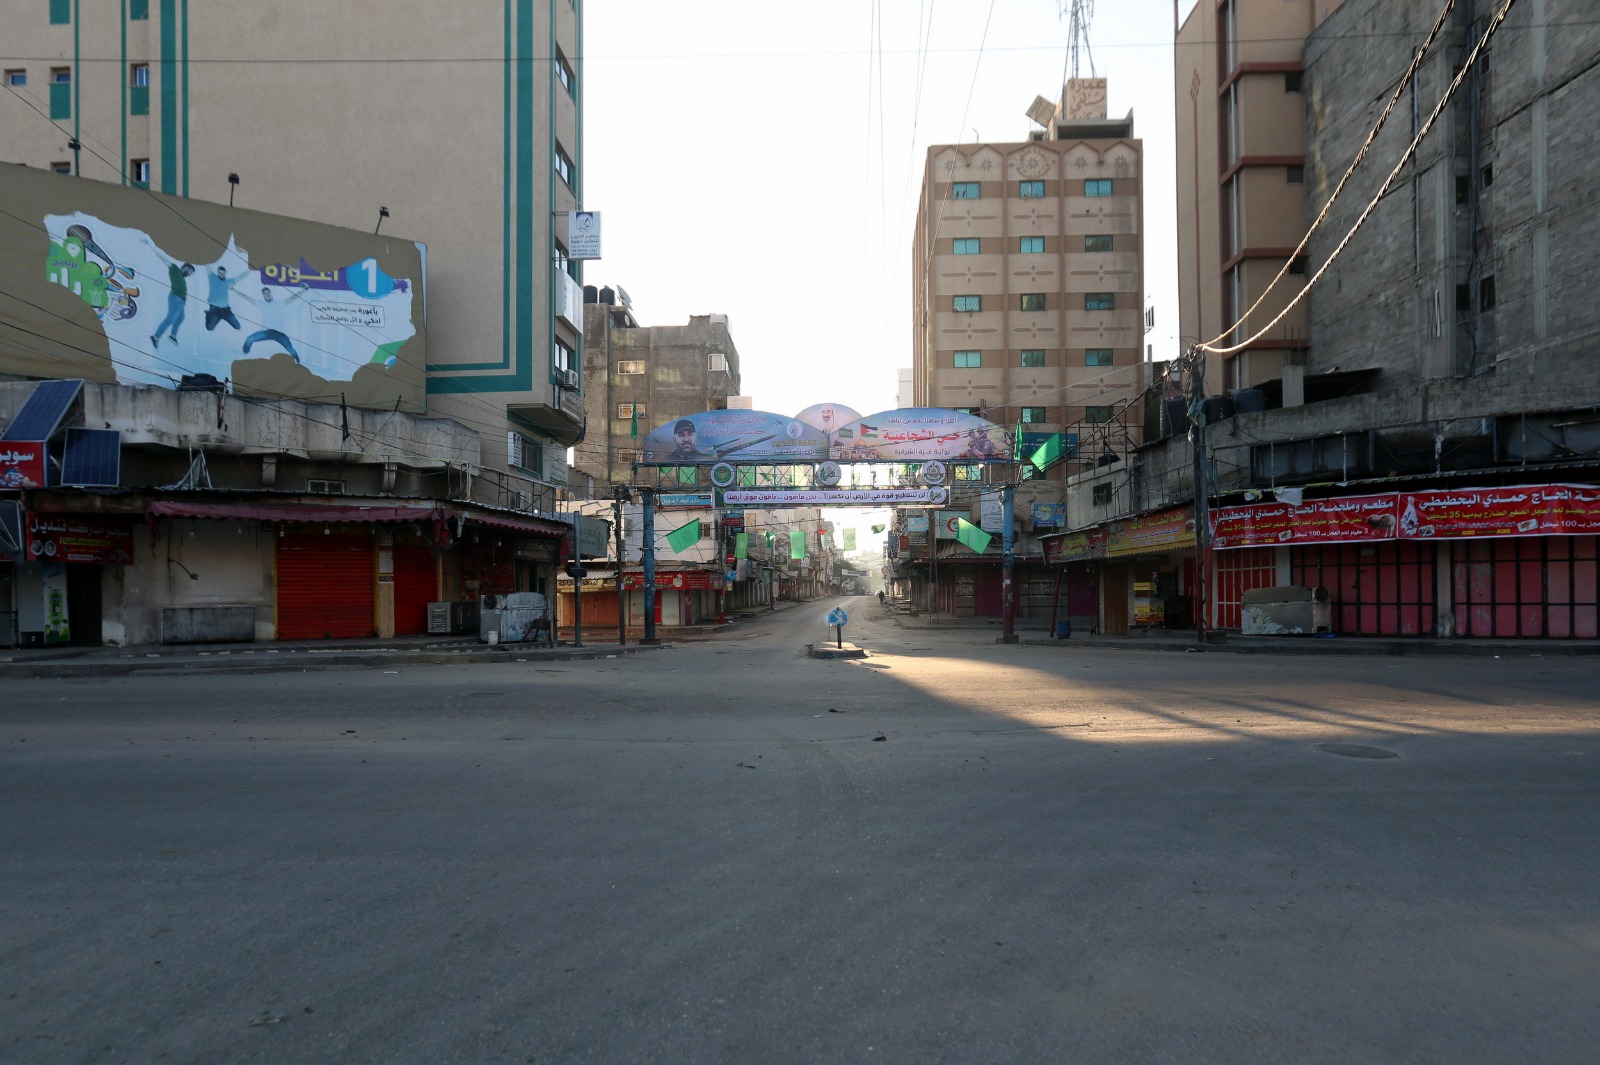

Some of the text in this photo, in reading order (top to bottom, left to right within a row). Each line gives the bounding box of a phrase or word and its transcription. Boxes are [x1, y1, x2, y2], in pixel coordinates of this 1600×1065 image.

[52, 259, 78, 269] برنامج
[362, 258, 376, 293] 1
[883, 428, 960, 445] حي الشجاعية
[894, 447, 918, 456] الشرقية
[871, 493, 880, 501] في
[895, 491, 918, 499] تستطيع
[918, 491, 926, 499] لن
[1482, 491, 1528, 507] حمدي
[1531, 490, 1572, 504] الحاج
[1319, 502, 1360, 514] وملحمة
[1362, 500, 1394, 513] مطعم
[1255, 509, 1285, 521] حمدي
[1288, 505, 1317, 518] الحاج
[1509, 509, 1530, 518] الصغير
[1426, 512, 1448, 521] شيكل
[1539, 520, 1560, 529] شيكل
[1560, 519, 1578, 527] 100
[1292, 531, 1307, 539] شيكل
[1326, 530, 1340, 538] العجل
[1339, 529, 1350, 537] لحم
[1350, 528, 1363, 536] كيلو
